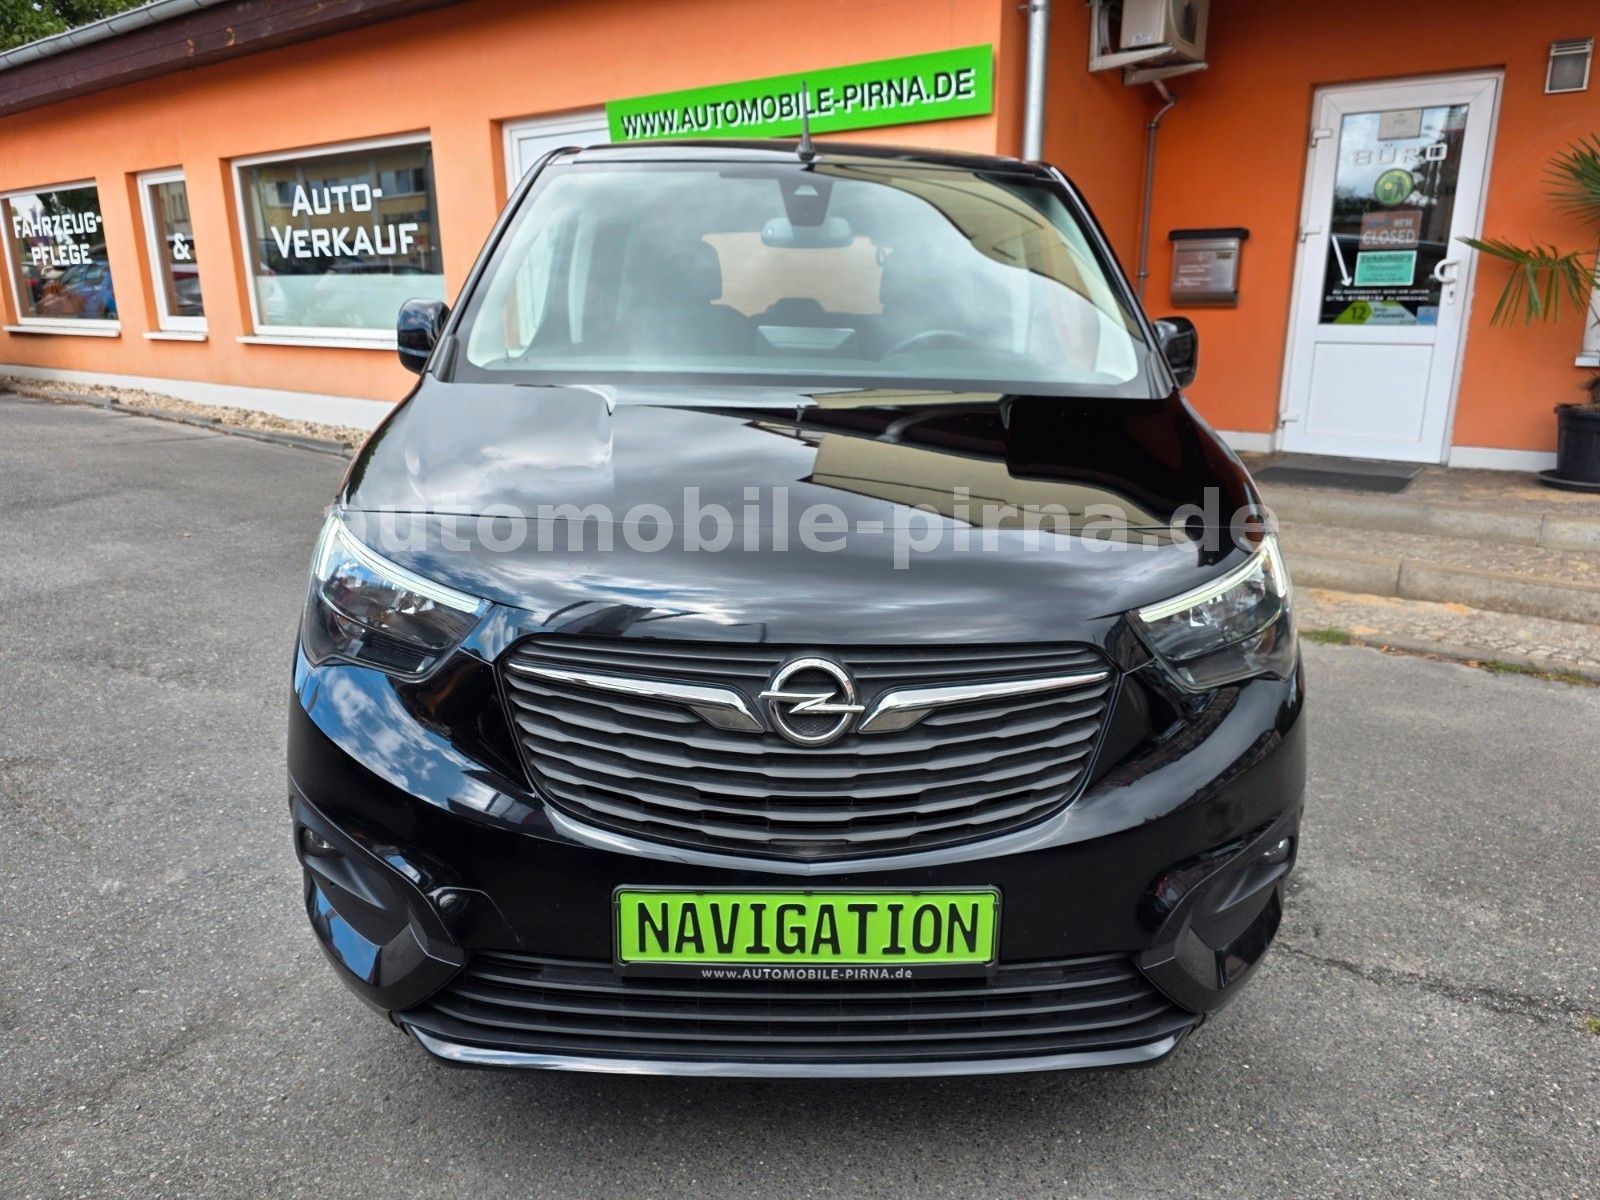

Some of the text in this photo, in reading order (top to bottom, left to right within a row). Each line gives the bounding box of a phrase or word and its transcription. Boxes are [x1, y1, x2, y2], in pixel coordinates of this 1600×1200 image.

[620, 67, 976, 140] WWW.AUTOMOBILE-PIRNA.DE
[1354, 142, 1448, 166] BÜRO
[12, 211, 102, 239] FAHRZEUG-
[1363, 229, 1416, 245] CLOSED
[172, 232, 192, 261] &
[270, 222, 418, 259] VERKAUF
[31, 243, 93, 267] PFLEGE
[1351, 306, 1366, 321] 12
[636, 902, 980, 956] NAVIGATION
[700, 967, 913, 981] www.AUTOMOBILE-PIRNA.de
